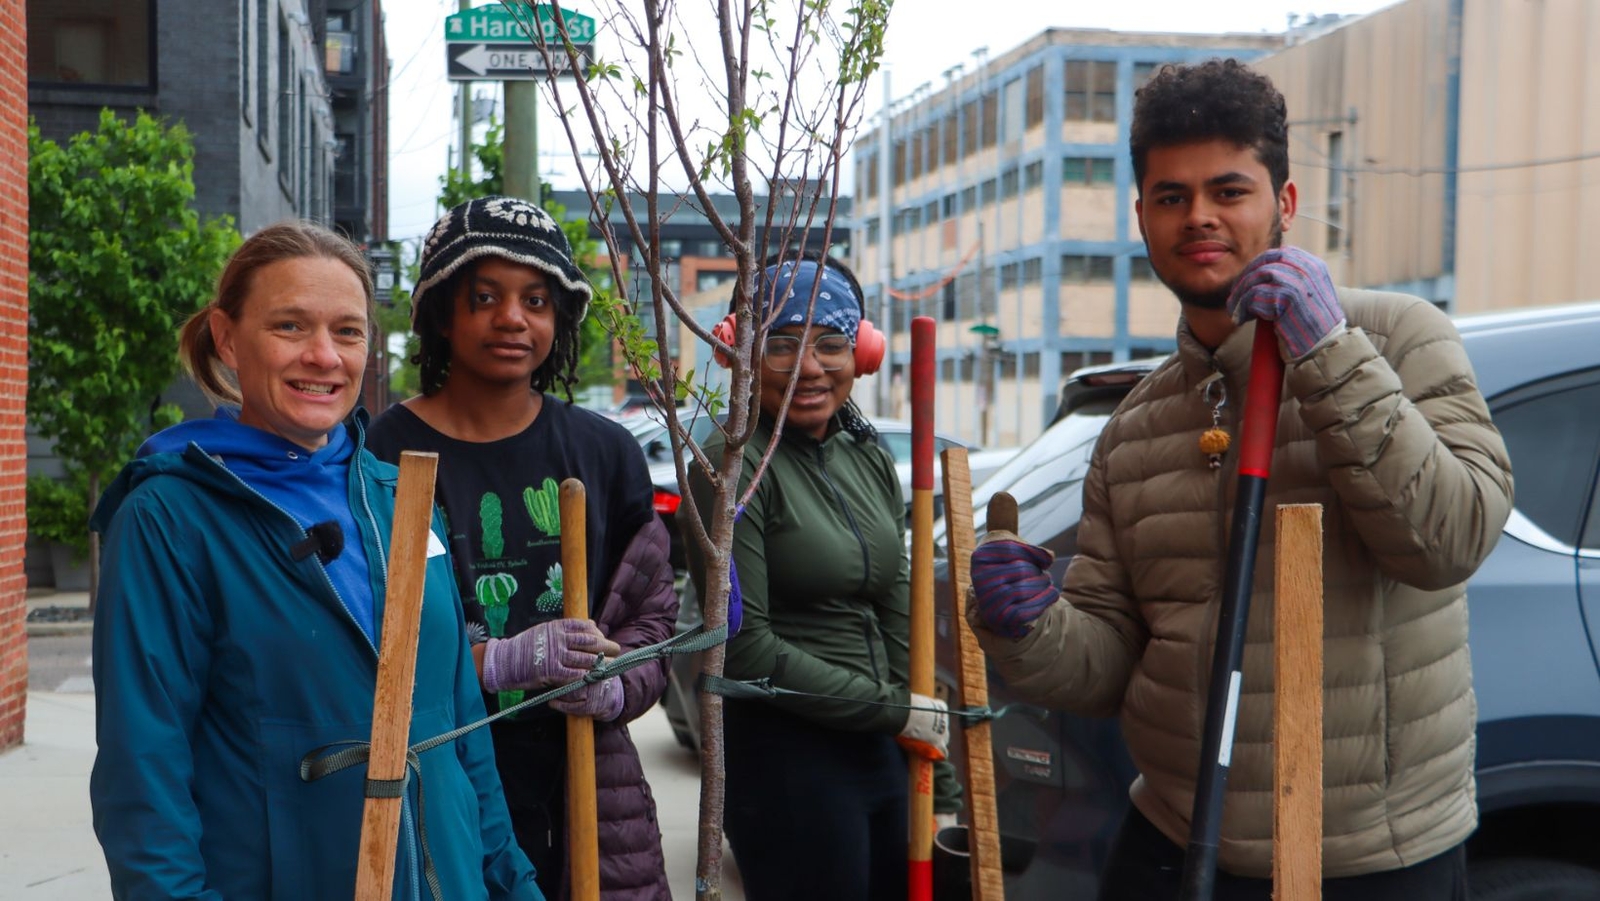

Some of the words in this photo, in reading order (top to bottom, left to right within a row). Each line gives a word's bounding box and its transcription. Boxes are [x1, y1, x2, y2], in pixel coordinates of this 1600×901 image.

[470, 16, 555, 38] Harold
[567, 18, 591, 39] St
[489, 53, 528, 68] ONE
